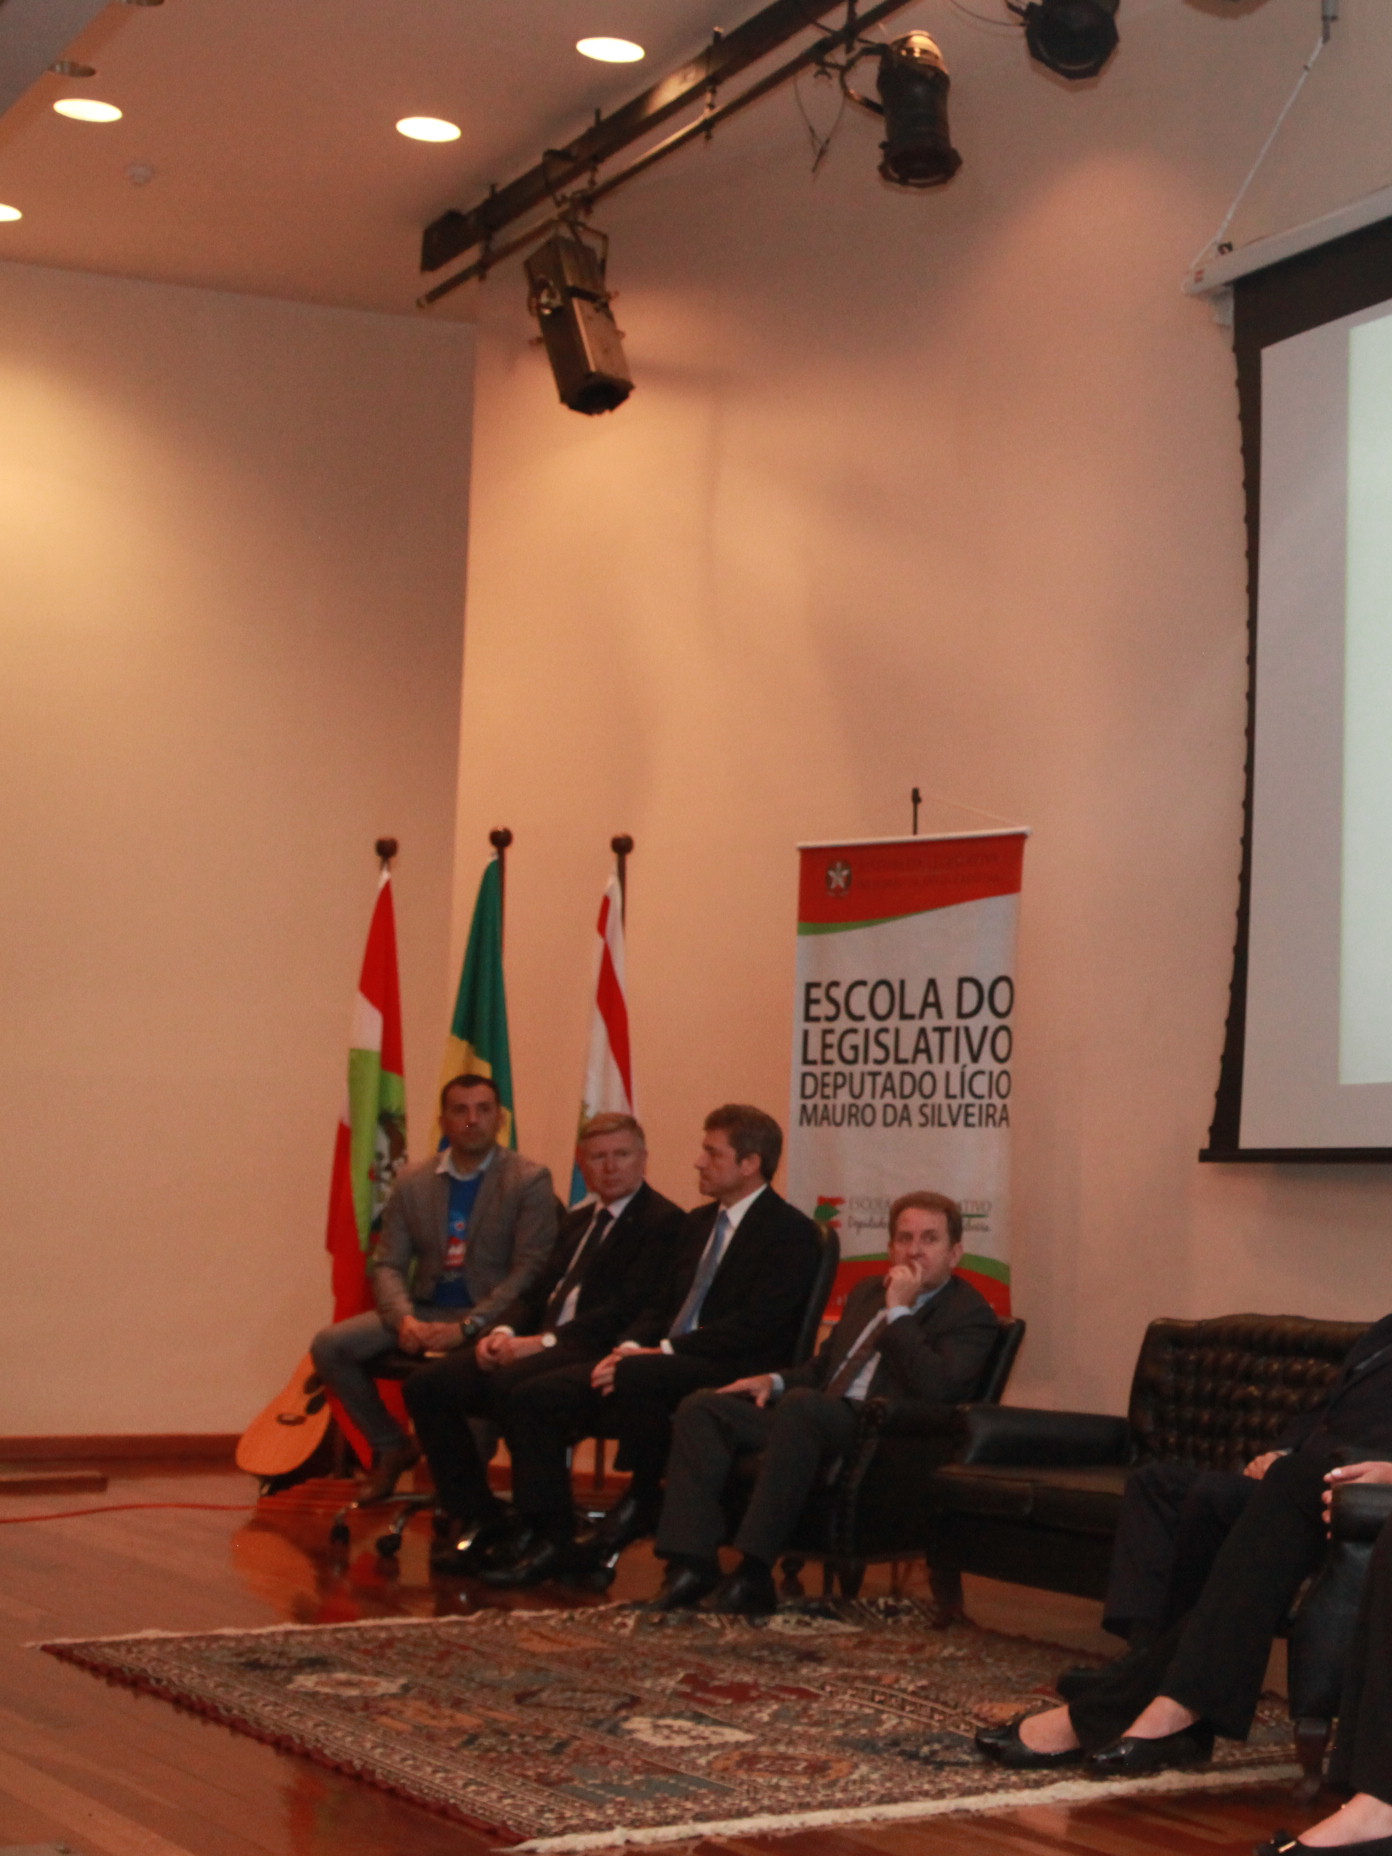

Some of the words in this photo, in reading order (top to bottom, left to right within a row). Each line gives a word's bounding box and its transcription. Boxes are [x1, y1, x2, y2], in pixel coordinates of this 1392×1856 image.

[803, 977, 944, 1023] ESCOLA
[956, 974, 1015, 1020] DO
[801, 1024, 1013, 1066] LEGISLATIVO
[800, 1070, 937, 1100] DEPUTADO
[944, 1064, 1012, 1100] LÍCIO
[799, 1103, 877, 1128] MAURO
[882, 1103, 913, 1128] DA
[918, 1103, 1011, 1128] SILVEIRA
